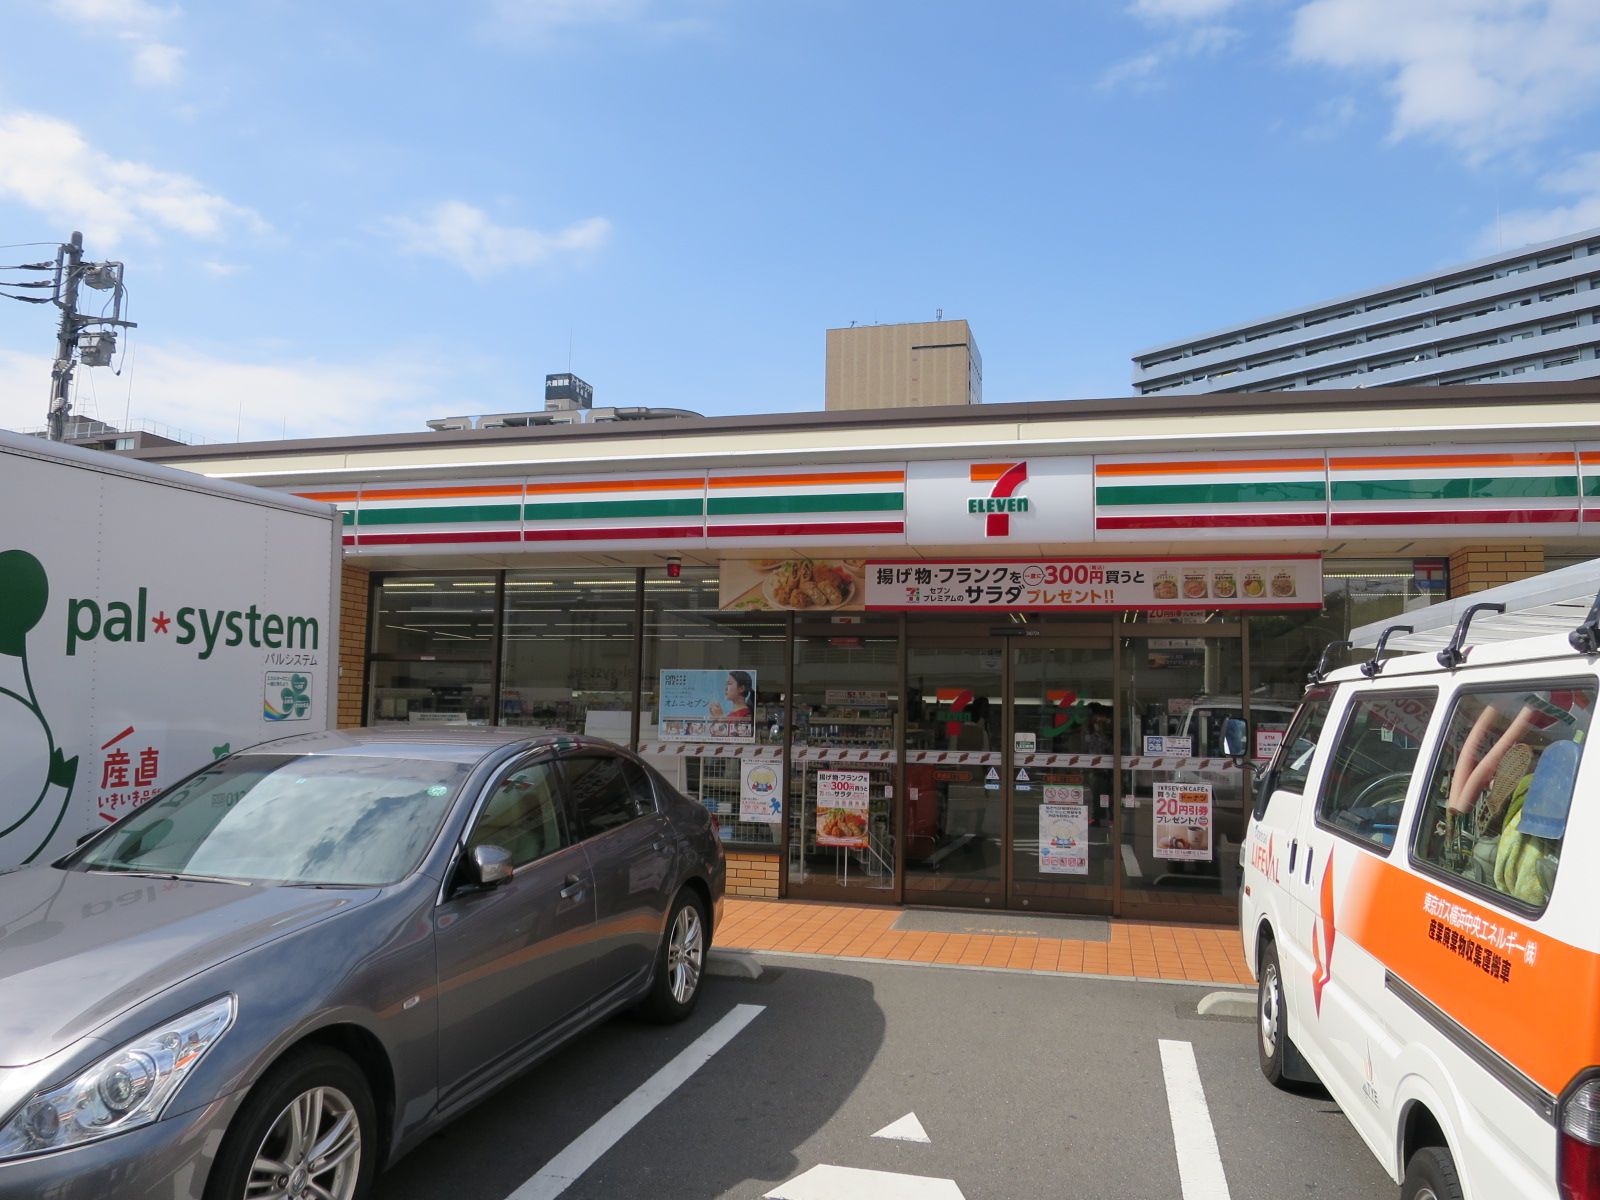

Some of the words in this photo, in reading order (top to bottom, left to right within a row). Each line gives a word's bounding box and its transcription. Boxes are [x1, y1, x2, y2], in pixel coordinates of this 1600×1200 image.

[965, 585, 1026, 604] サラダ
[66, 587, 148, 656] pal
[176, 604, 320, 660] system
[101, 747, 159, 790] 産直
